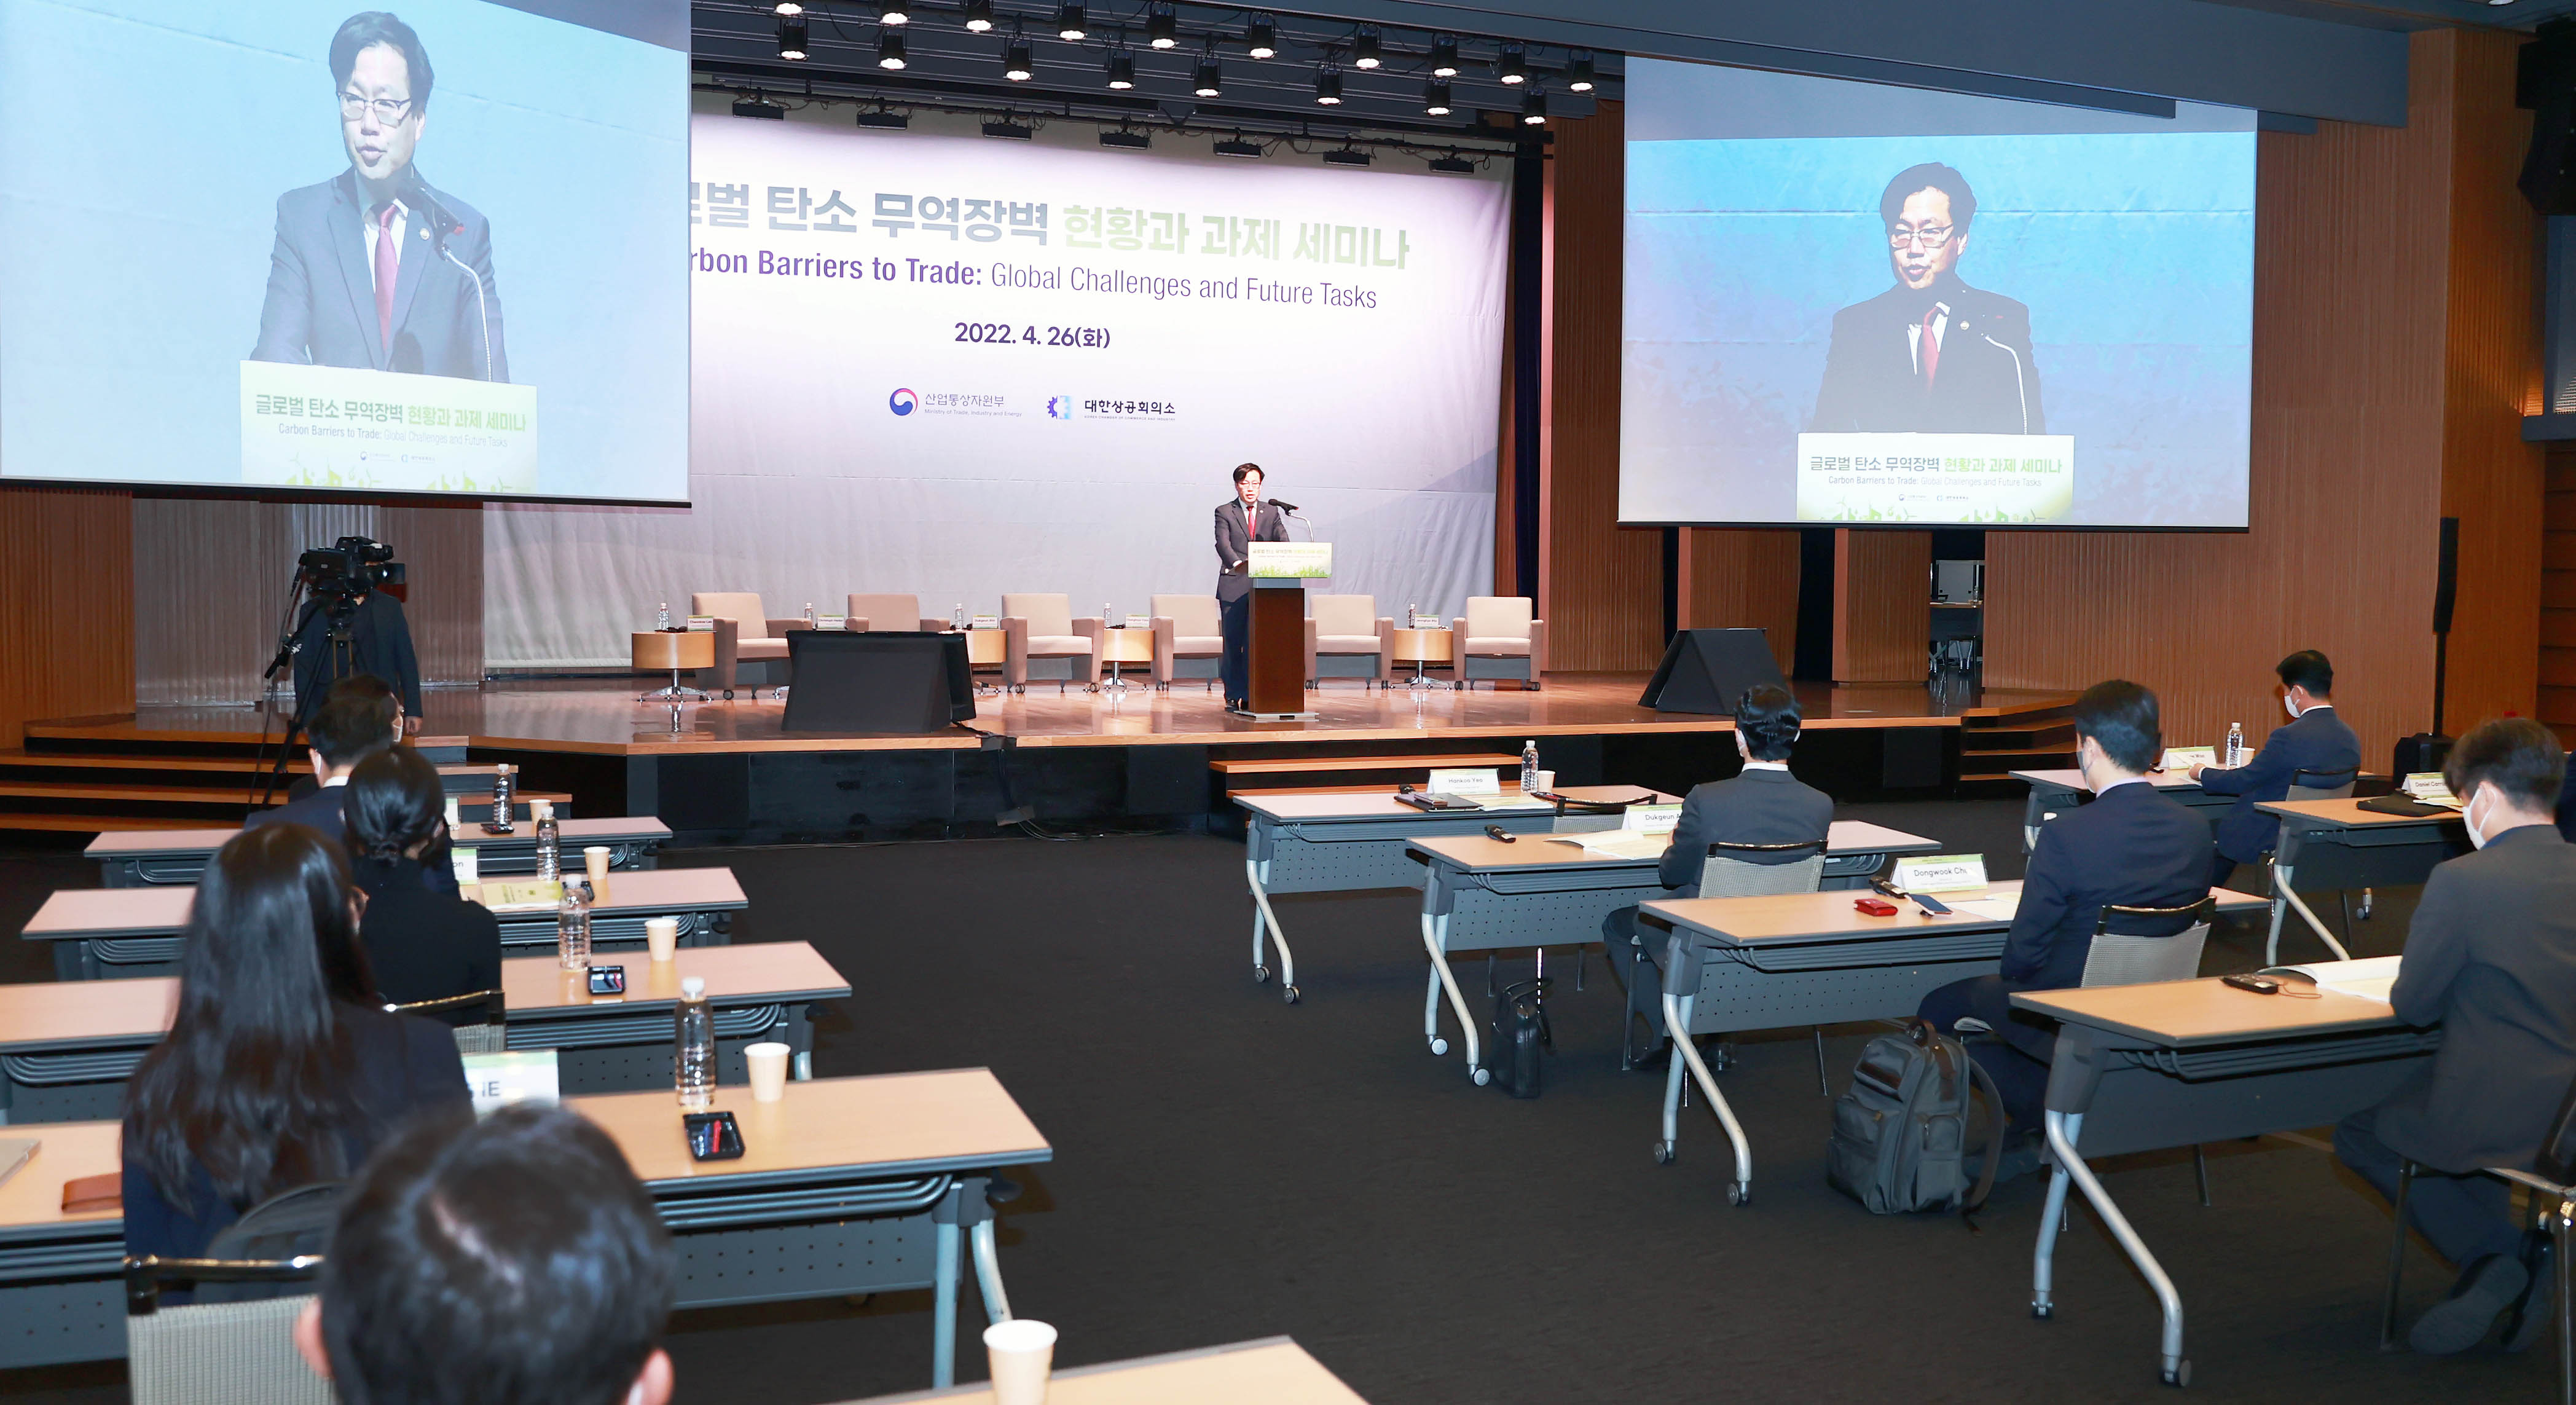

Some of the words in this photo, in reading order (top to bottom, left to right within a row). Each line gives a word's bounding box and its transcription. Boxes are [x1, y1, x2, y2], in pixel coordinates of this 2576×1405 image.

[691, 182, 749, 228] 벌
[768, 186, 857, 234] 탄소
[873, 193, 1048, 245] 무역장벽
[1063, 205, 1189, 254] 현황과
[1201, 216, 1279, 261] 과제
[1293, 222, 1410, 270] 세미나
[758, 250, 862, 280] Barriers
[873, 257, 896, 281] to
[906, 258, 982, 286] Trade:
[992, 262, 1060, 289] Global
[1070, 267, 1191, 300] Challenges
[1200, 277, 1238, 299] and
[1247, 278, 1313, 304] Future
[1320, 282, 1376, 309] Tasks
[955, 322, 1016, 344] 2022.
[1022, 326, 1041, 345] 4.
[1047, 326, 1110, 349] 26(화)
[925, 393, 1005, 408] 산업통상자원부
[1085, 399, 1176, 415] 대한상공회의소
[256, 394, 304, 417] 글로벌
[309, 398, 339, 418] 탄소
[344, 401, 403, 423] 무역장벽
[408, 404, 451, 427] 현황과
[455, 409, 482, 429] 과제
[486, 411, 527, 431] 세미나
[278, 423, 308, 435] Carbon
[312, 425, 345, 438] Barriers
[347, 428, 355, 438] to
[357, 428, 382, 439] Trade:
[383, 429, 406, 441] Global
[409, 431, 447, 445] Challenges
[449, 433, 463, 445] and
[465, 434, 486, 446] Future
[488, 436, 508, 447] Tasks
[1810, 456, 1850, 471] 글로벌
[1855, 457, 1881, 471] 탄소
[1886, 457, 1939, 472] 무역장벽
[1944, 457, 1985, 473] 현황과
[1989, 458, 2016, 473] 과제
[2020, 458, 2062, 473] 세미나
[1828, 476, 1854, 484] Carbon
[1856, 476, 1885, 485] Barriers
[1897, 476, 1918, 485] Trade:
[1921, 477, 1942, 486] Global
[1944, 477, 1982, 487] Challenges
[1983, 478, 1996, 486] and
[1998, 478, 2020, 486] Future
[2022, 478, 2042, 487] Tasks
[1914, 867, 1952, 878] Dongwook
